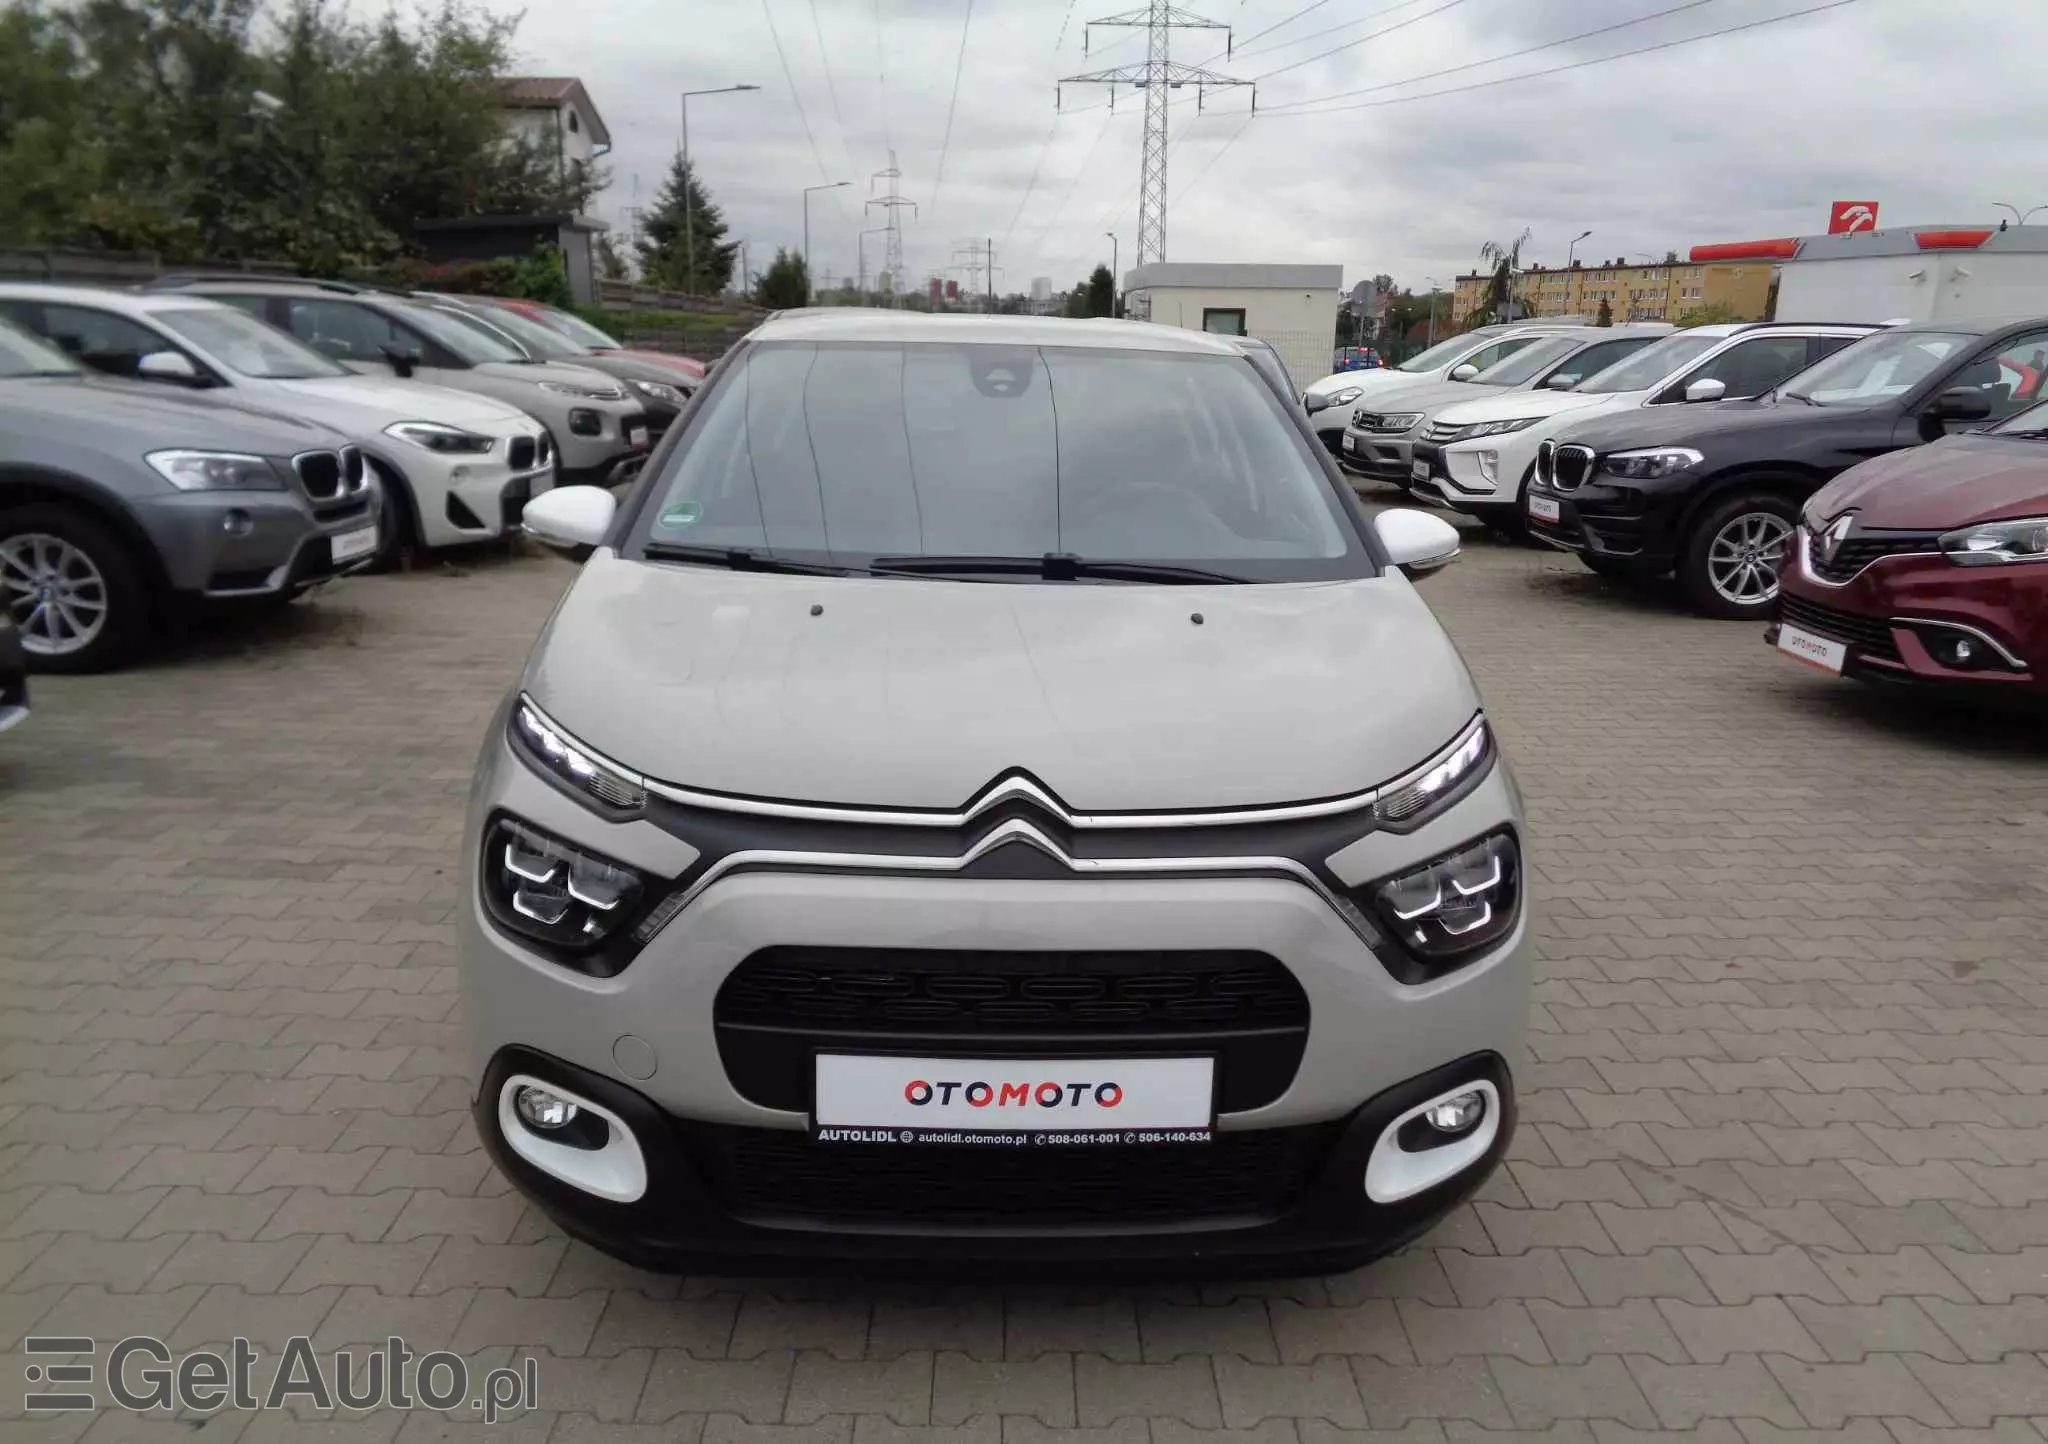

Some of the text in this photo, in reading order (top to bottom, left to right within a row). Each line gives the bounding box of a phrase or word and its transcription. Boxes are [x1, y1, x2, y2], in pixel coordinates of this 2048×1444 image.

[904, 1080, 1123, 1108] OTOMOTO
[818, 1129, 897, 1143] AUTOLIDL
[918, 1132, 1028, 1146] autolidl.otomoto.pl
[1048, 1133, 1121, 1144] 508-061-001
